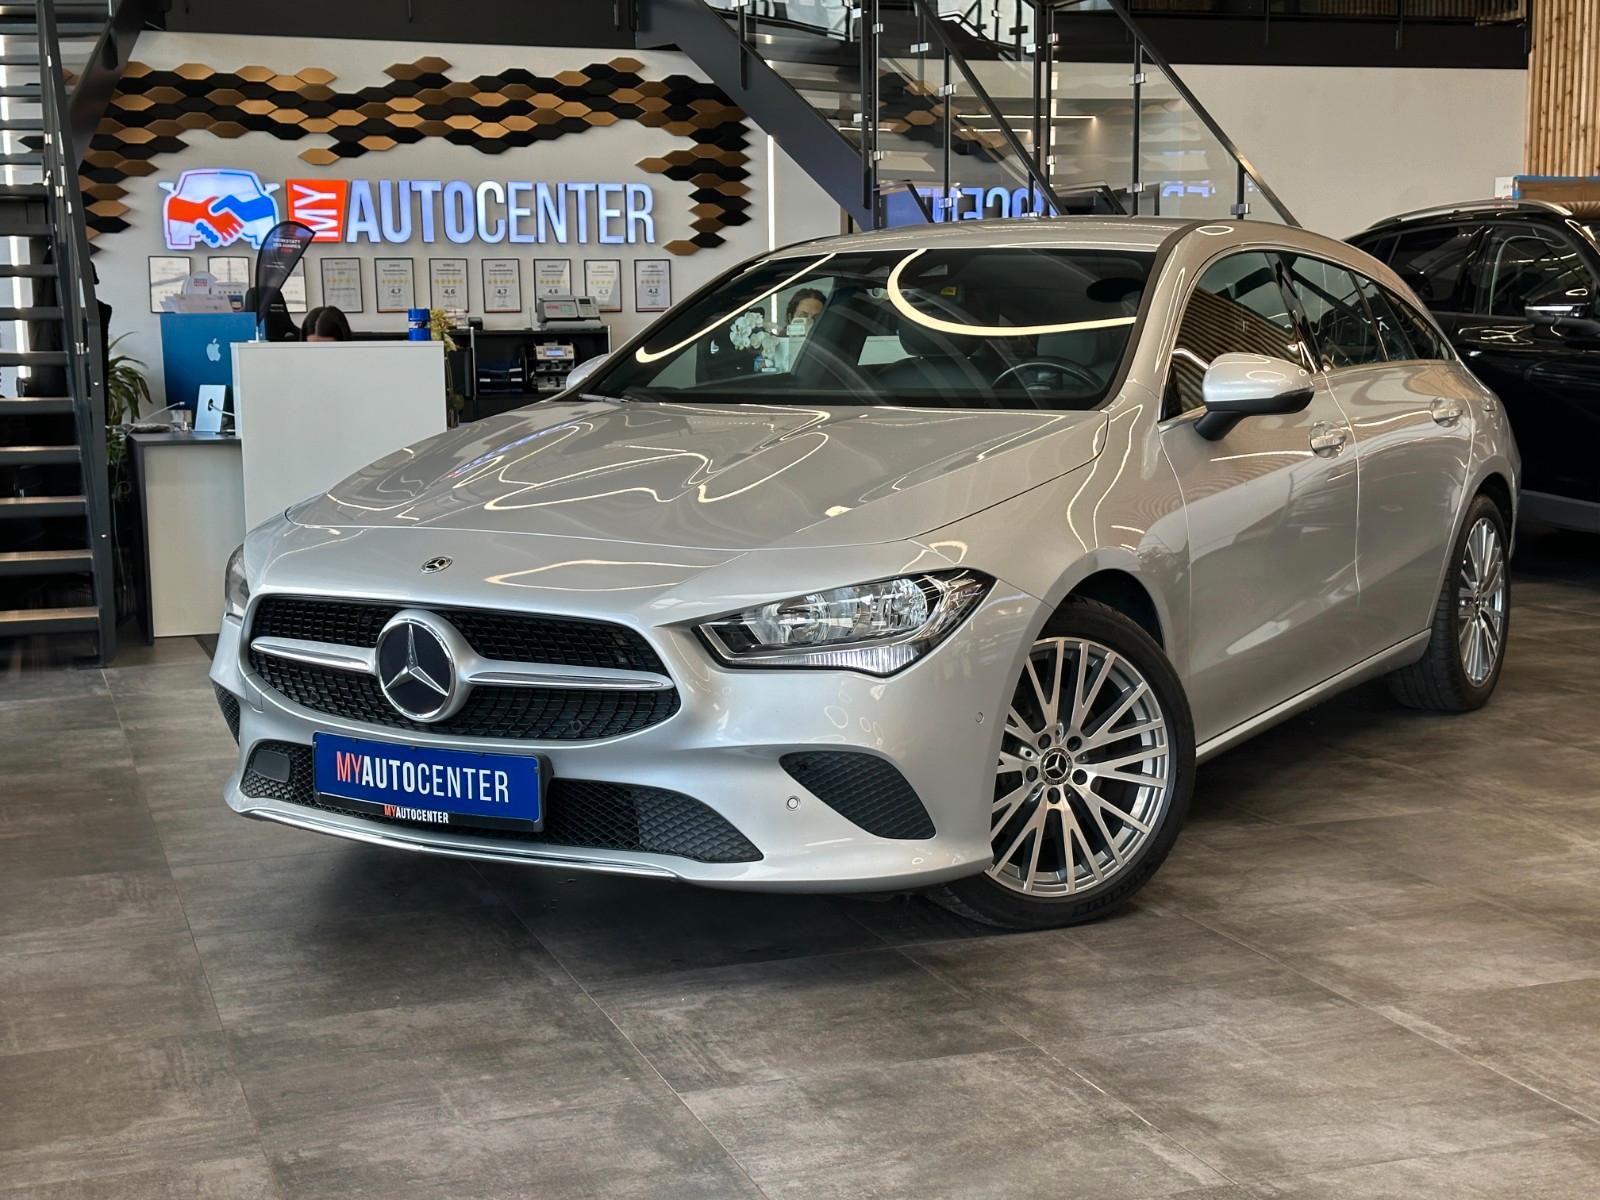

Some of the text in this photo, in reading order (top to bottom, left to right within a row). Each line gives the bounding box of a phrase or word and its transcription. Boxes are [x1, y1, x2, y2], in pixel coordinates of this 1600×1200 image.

[346, 179, 655, 244] AUTOCENTER
[336, 751, 509, 803] MYAUTOCENTER
[384, 804, 449, 824] MYAUTOCENTER
